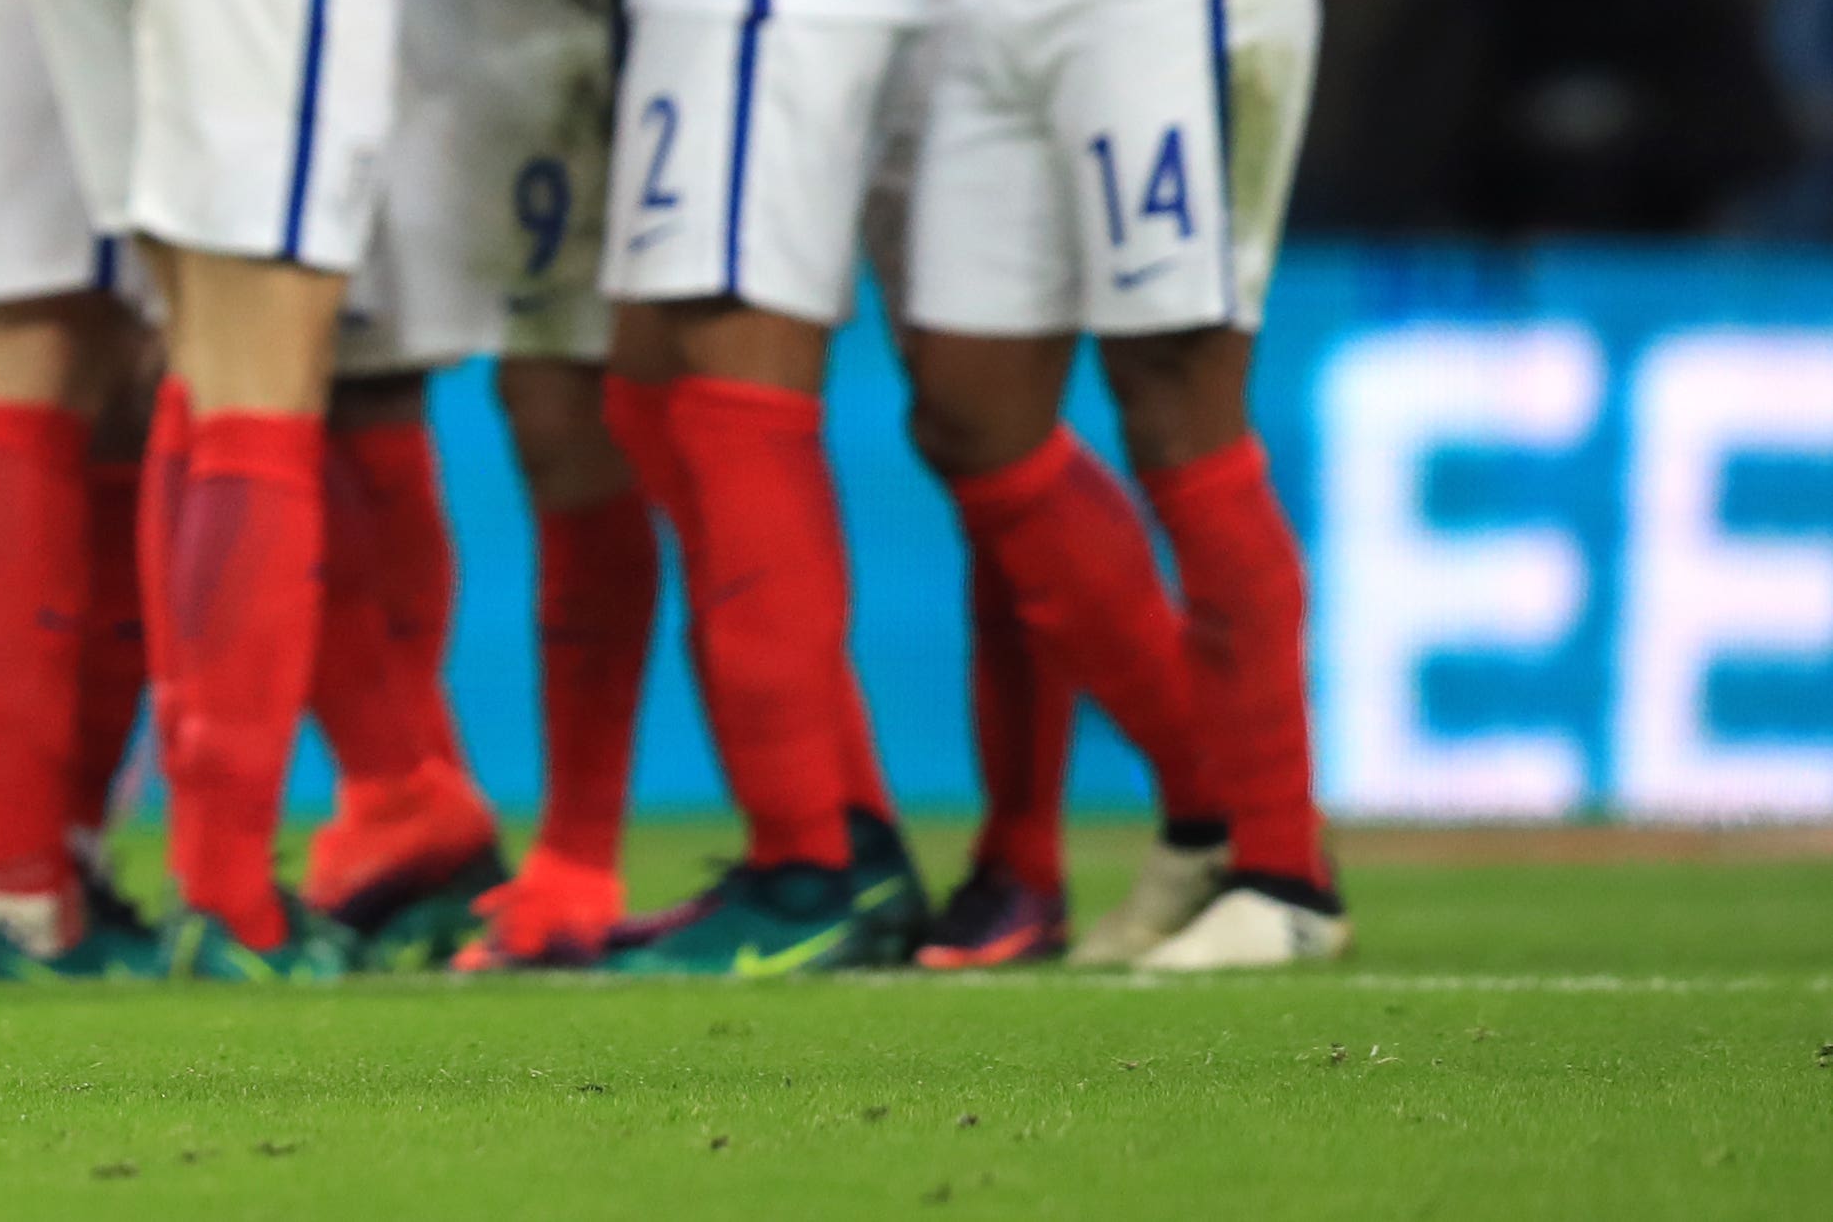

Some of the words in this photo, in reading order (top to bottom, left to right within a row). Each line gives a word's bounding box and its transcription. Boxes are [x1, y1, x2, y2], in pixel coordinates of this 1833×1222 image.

[642, 94, 682, 209] 2
[1087, 124, 1194, 248] 14
[514, 155, 571, 276] 9
[1312, 320, 1832, 820] EE
